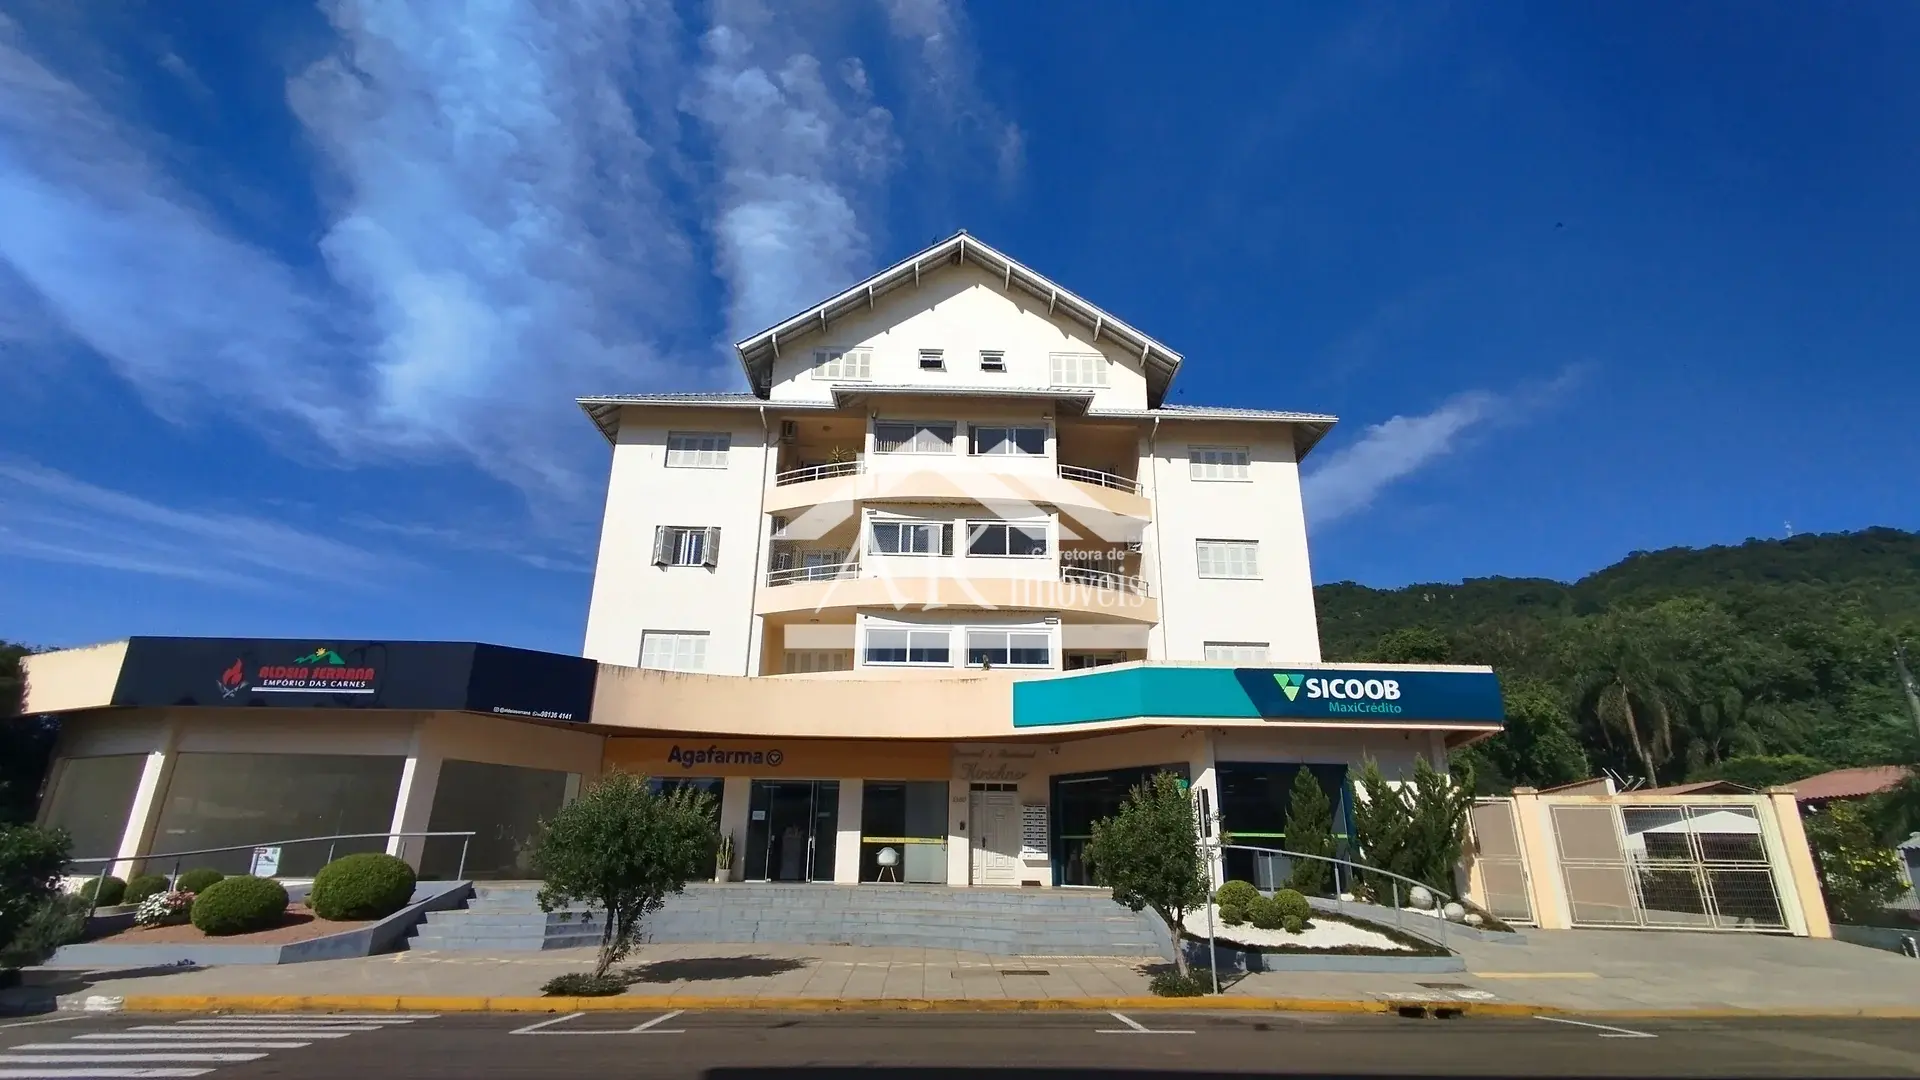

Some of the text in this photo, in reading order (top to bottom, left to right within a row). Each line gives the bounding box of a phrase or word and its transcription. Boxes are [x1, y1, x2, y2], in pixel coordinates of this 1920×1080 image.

[263, 679, 305, 687] EMPÓRIO
[331, 680, 366, 688] CARNES
[1306, 678, 1400, 700] SICOOB
[1329, 702, 1402, 713] MaxiCrédito
[667, 744, 764, 769] Agafarma
